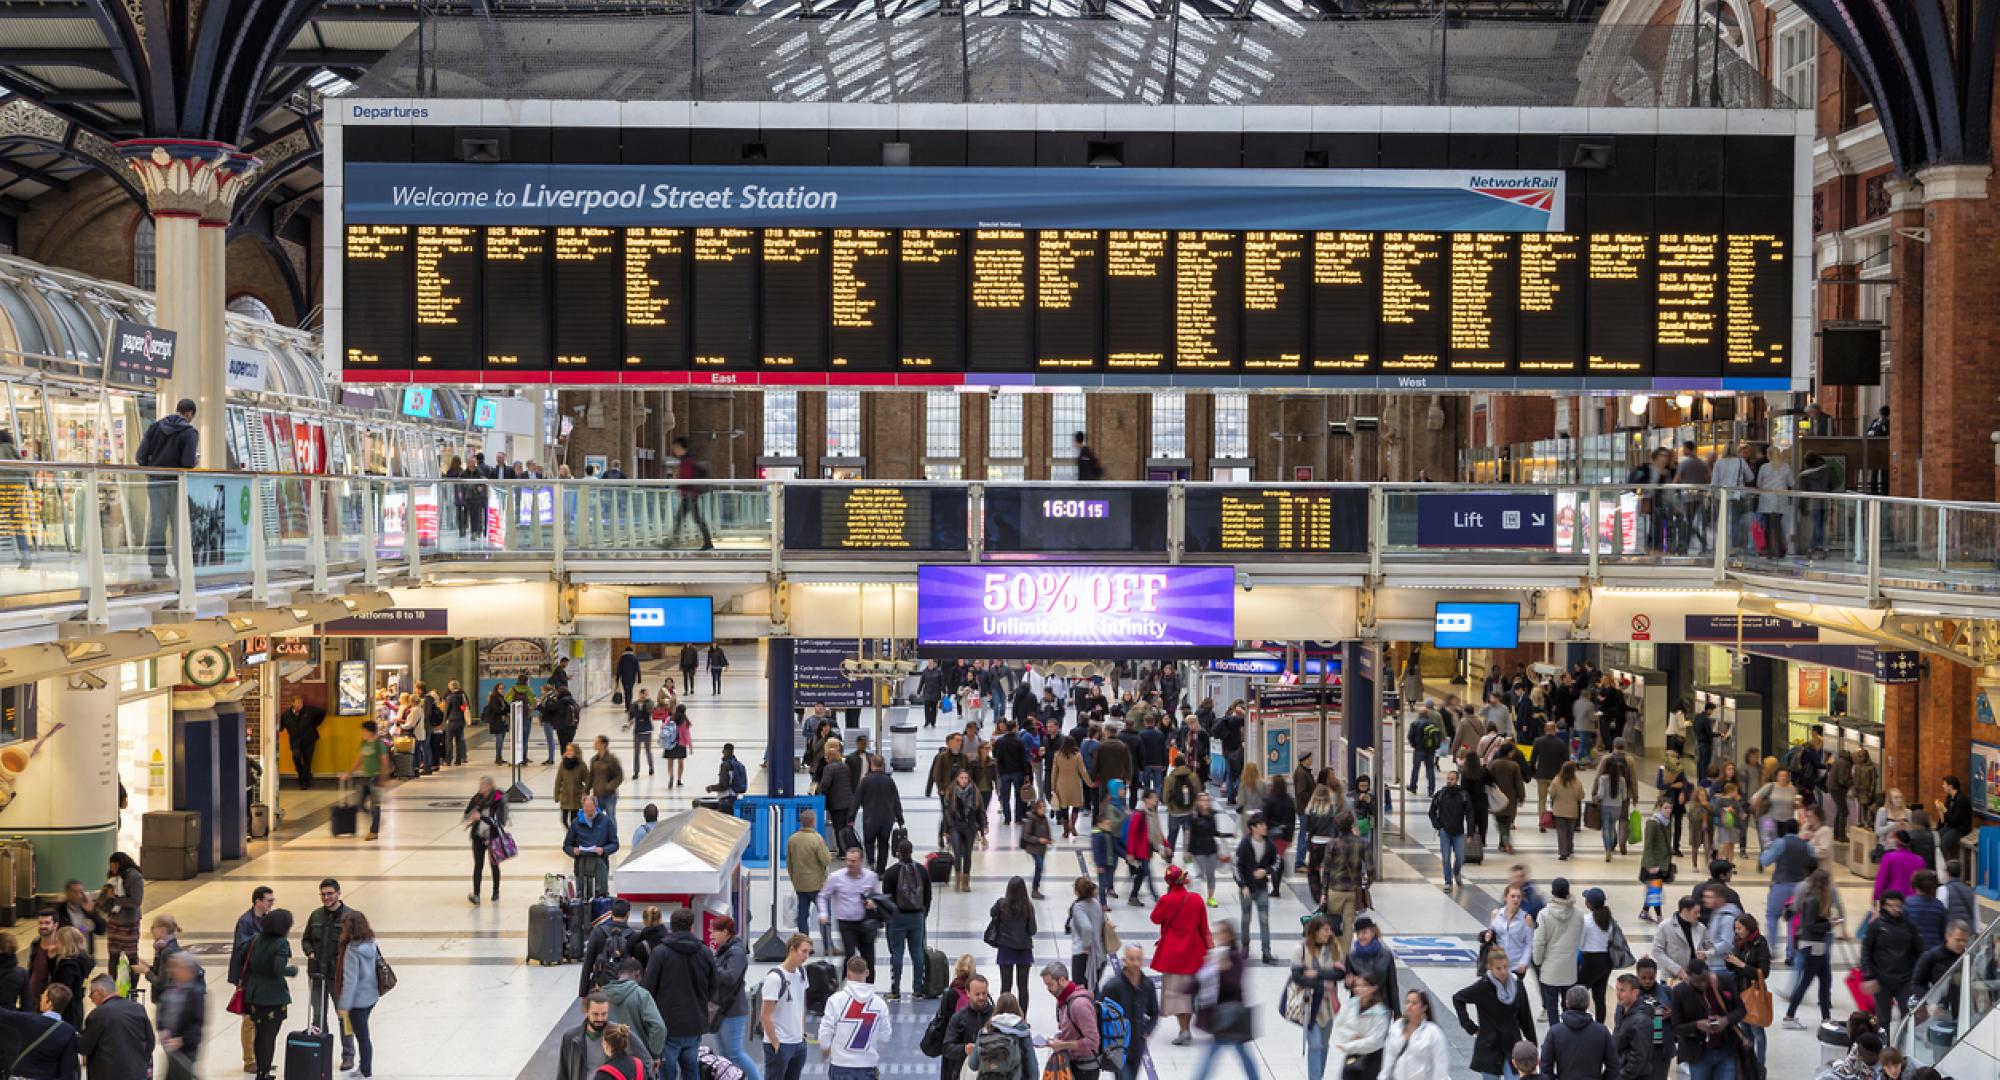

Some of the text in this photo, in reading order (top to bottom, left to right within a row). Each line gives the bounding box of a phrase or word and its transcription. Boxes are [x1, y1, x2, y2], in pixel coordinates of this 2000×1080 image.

[353, 106, 429, 120] Departures
[1470, 175, 1559, 189] NetworkRail
[393, 184, 838, 215] Welcome to Liverpool Street Station
[711, 373, 736, 385] East
[1398, 377, 1427, 388] West
[1043, 500, 1103, 518] 16:01 15
[1454, 511, 1483, 528] Lift
[983, 572, 1168, 614] 50% OFF
[395, 611, 402, 620] 8
[404, 611, 413, 620] to
[415, 611, 425, 620] 18
[1764, 617, 1780, 628] Lift
[276, 644, 309, 654] CASA
